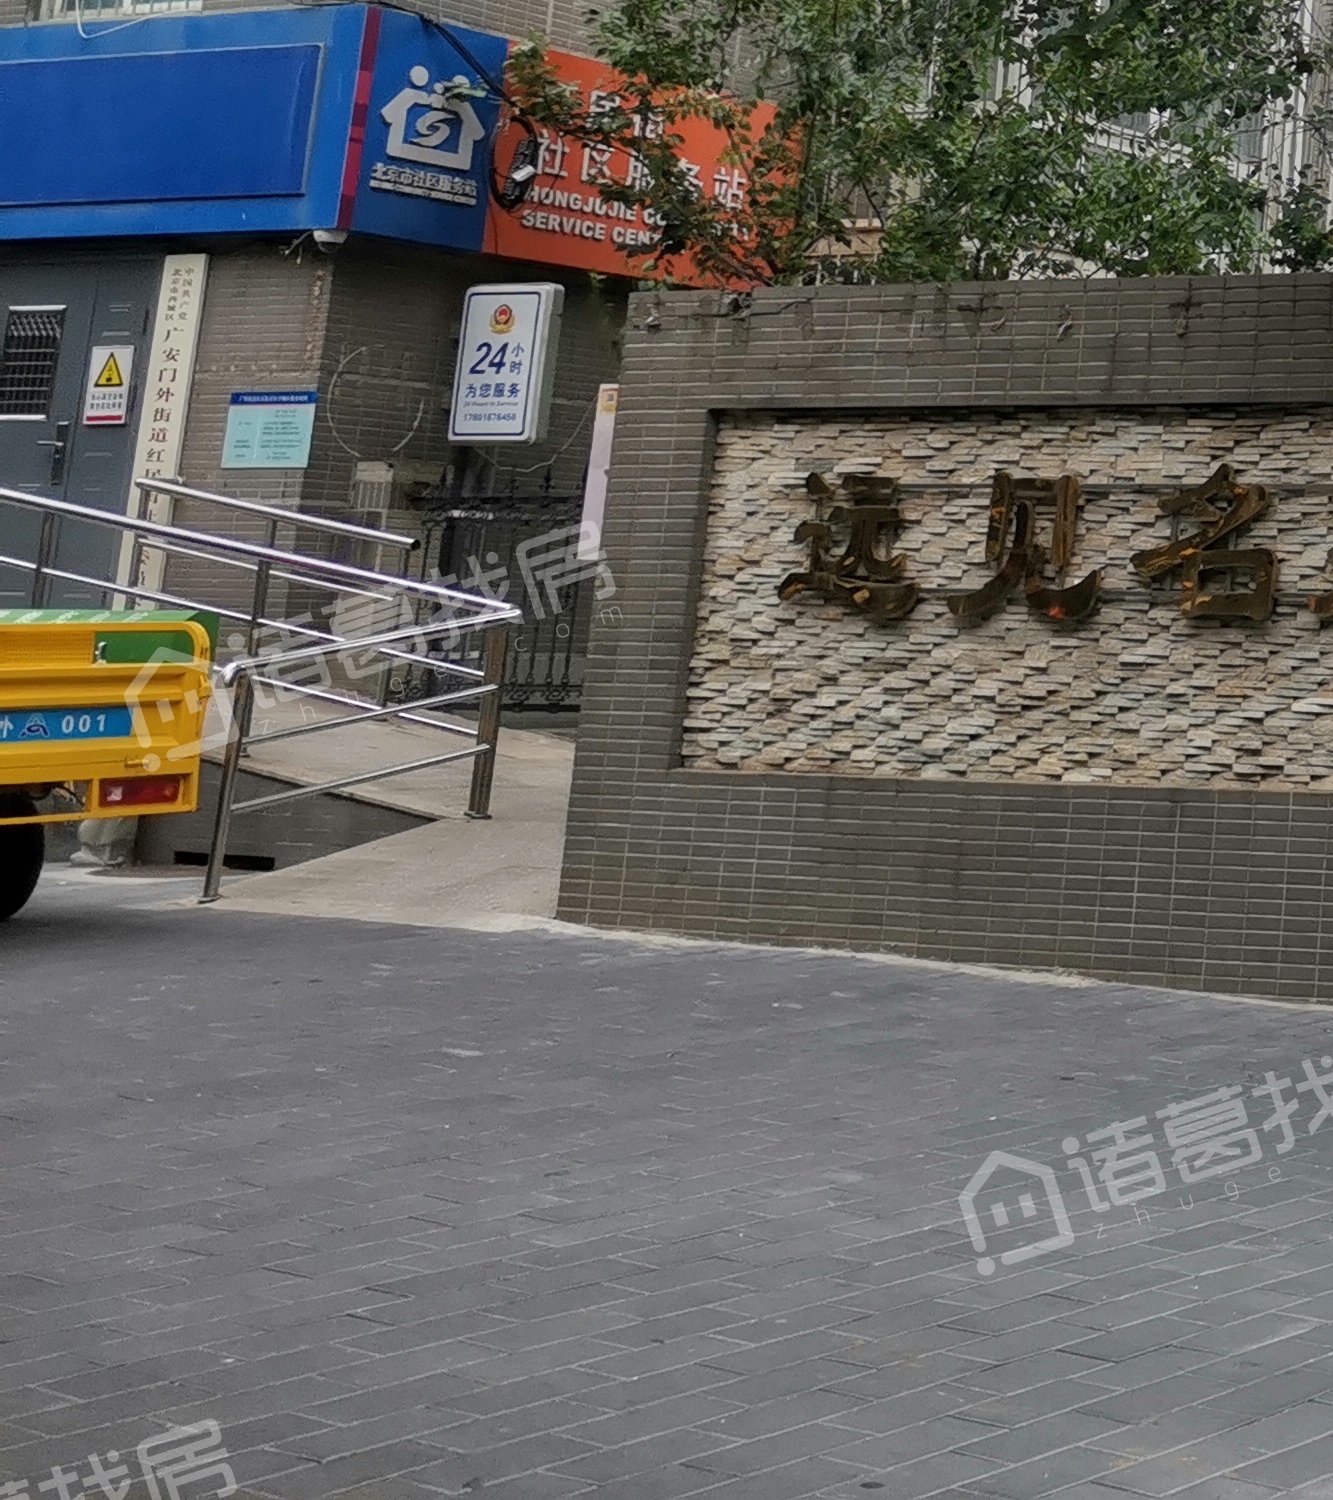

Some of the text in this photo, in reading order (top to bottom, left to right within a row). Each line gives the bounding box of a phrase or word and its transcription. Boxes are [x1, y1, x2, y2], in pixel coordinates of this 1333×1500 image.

[521, 209, 606, 241] SERVICE
[178, 267, 195, 321] 中国共产党
[468, 341, 525, 375] 24 小时
[465, 383, 521, 399] 为您服务
[62, 714, 106, 734] 001
